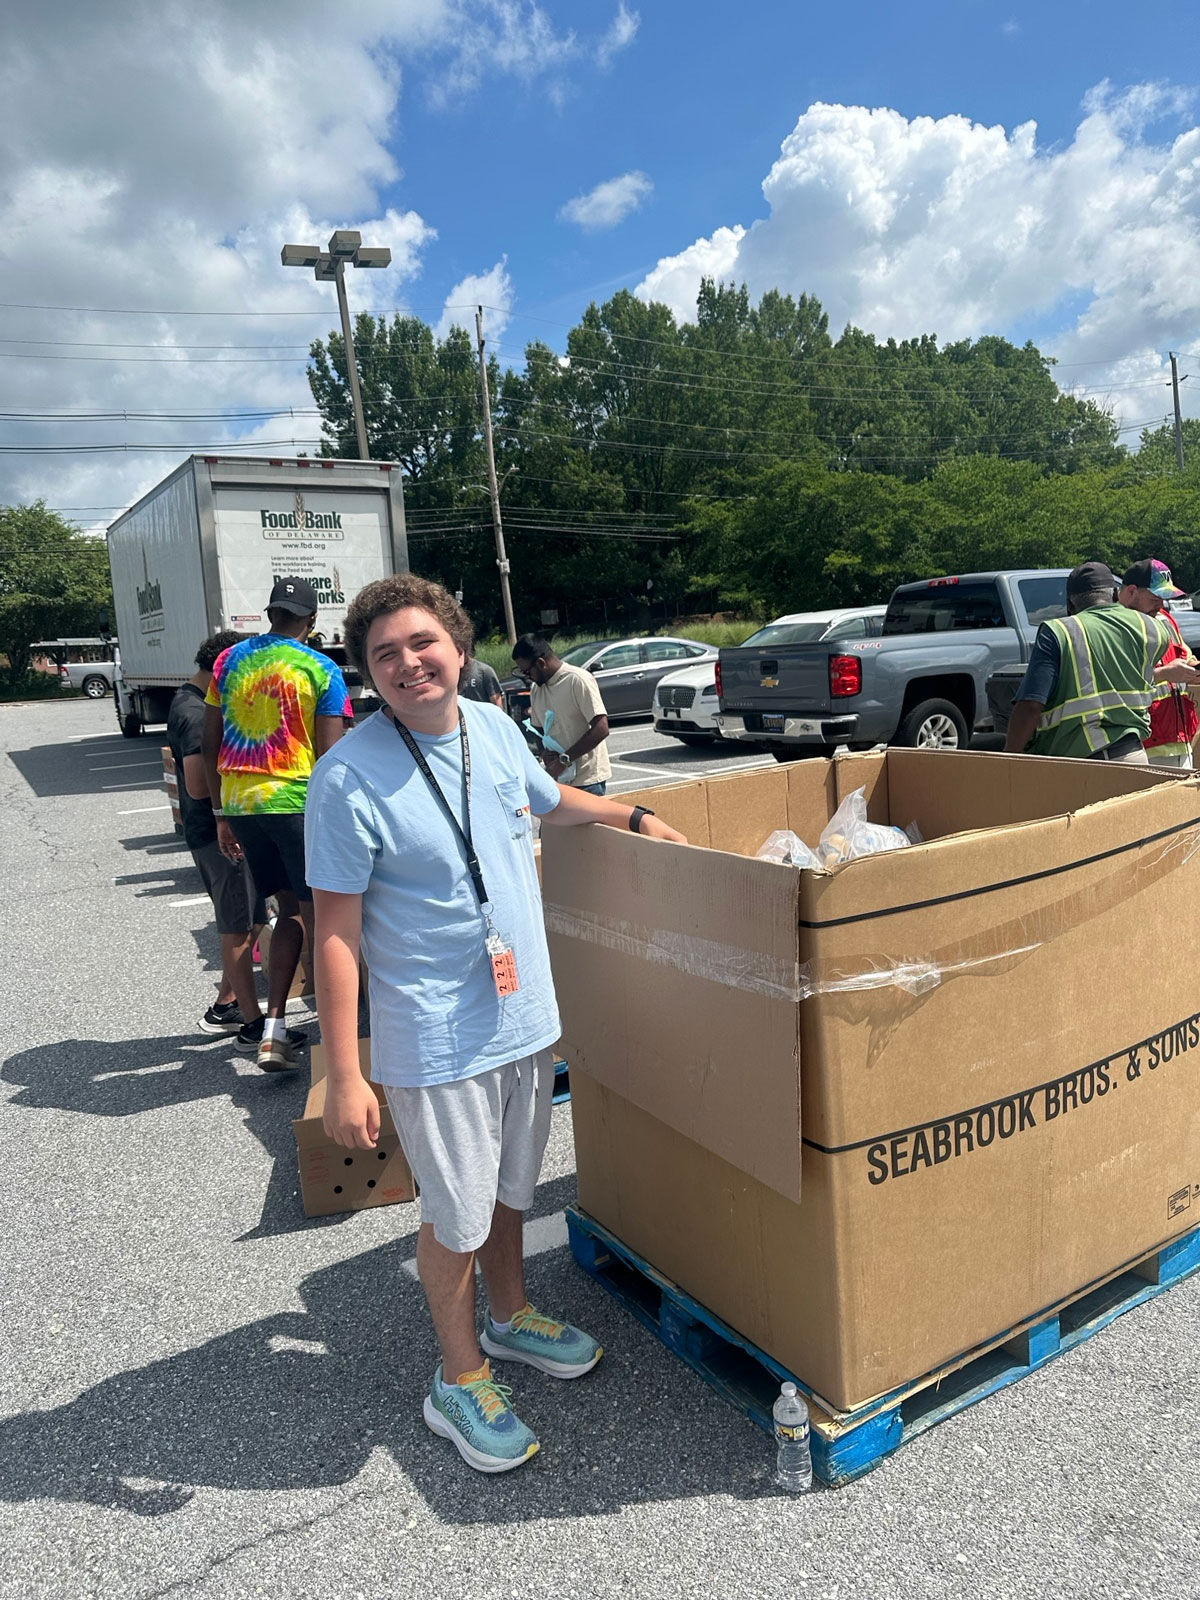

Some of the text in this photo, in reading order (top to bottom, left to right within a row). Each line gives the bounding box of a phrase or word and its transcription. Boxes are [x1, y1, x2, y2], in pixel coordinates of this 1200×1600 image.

[260, 509, 342, 529] Food Bank
[281, 542, 326, 550] www.fbd.org
[273, 575, 332, 589] Dware
[318, 589, 345, 604] orks
[495, 959, 503, 967] 2
[497, 971, 505, 979] 2
[499, 984, 507, 992] 2
[867, 1017, 1199, 1185] SEABROOK BROS. & SONS
[442, 1394, 475, 1440] HOKA
